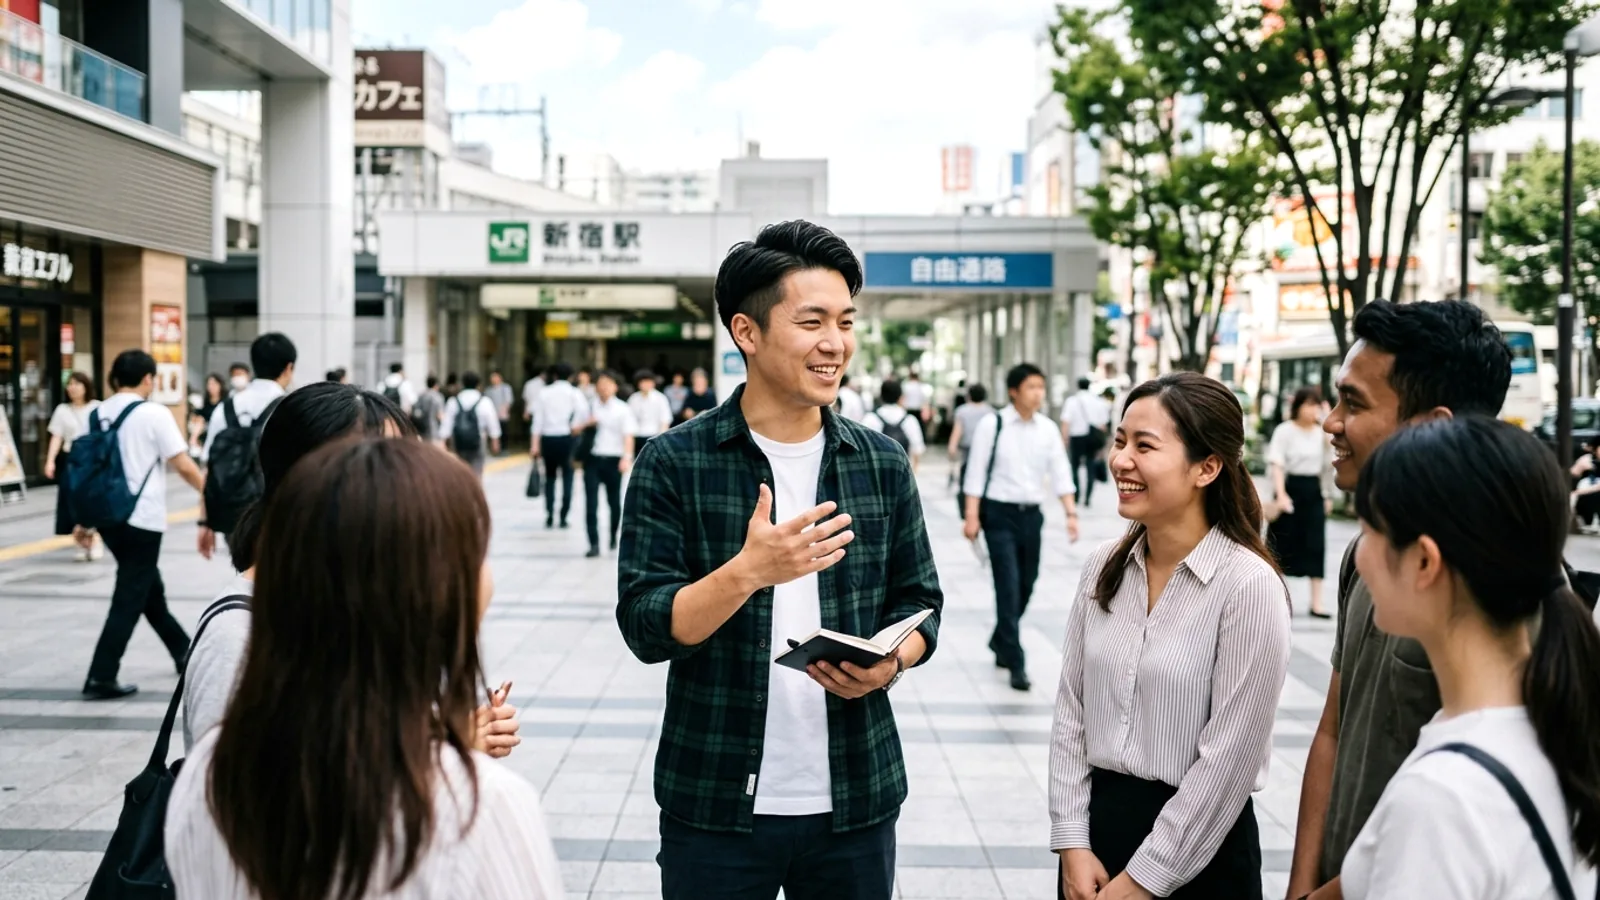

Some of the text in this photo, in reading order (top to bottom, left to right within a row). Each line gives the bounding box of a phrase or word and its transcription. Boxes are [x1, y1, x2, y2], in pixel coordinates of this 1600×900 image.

[355, 78, 422, 112] カフェ
[490, 227, 527, 249] JR
[544, 222, 640, 248] 新宿駅
[911, 256, 1006, 283] 自由通路
